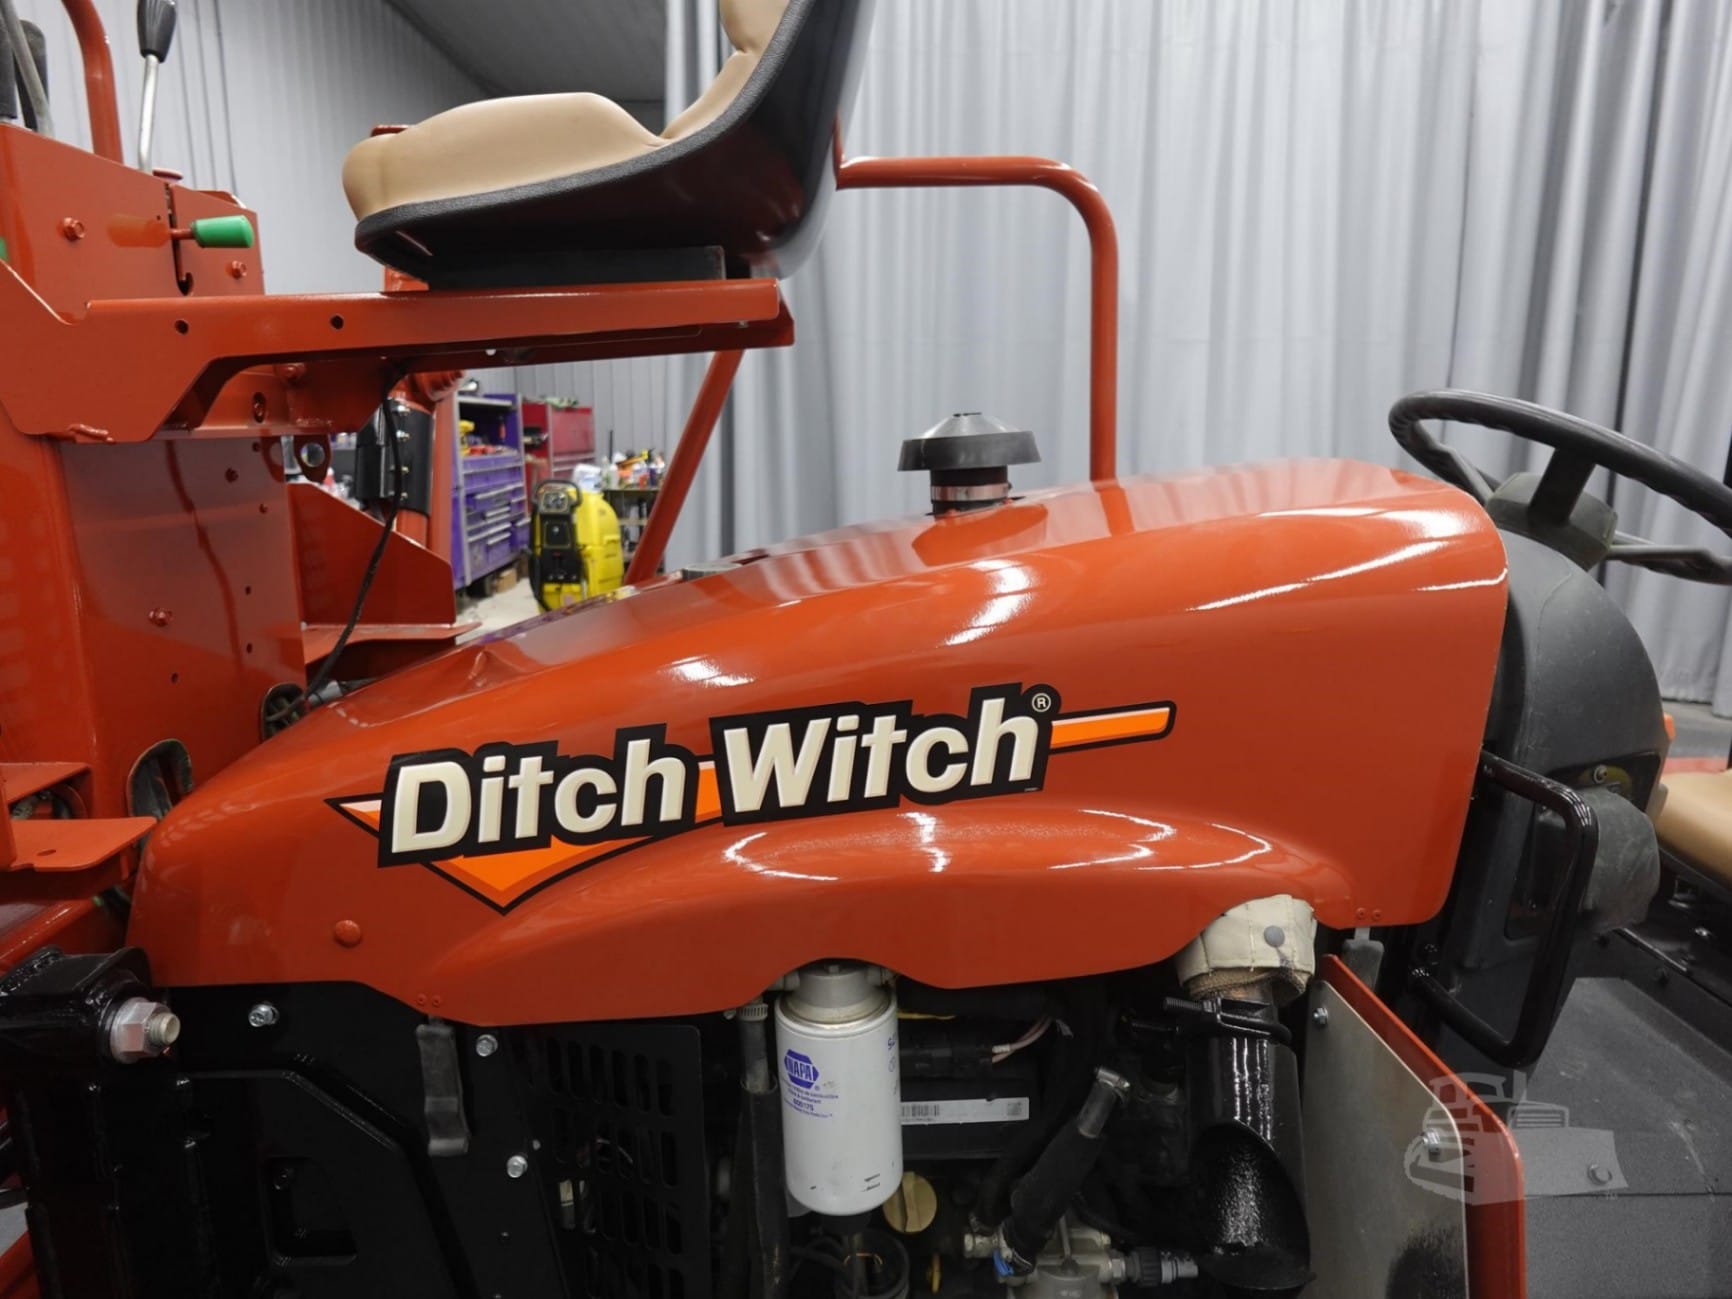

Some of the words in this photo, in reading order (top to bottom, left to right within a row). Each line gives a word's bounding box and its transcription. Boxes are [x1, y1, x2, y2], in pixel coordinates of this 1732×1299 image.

[391, 738, 686, 853] Ditch
[723, 697, 1039, 813] Witch
[786, 1055, 813, 1081] NAPA
